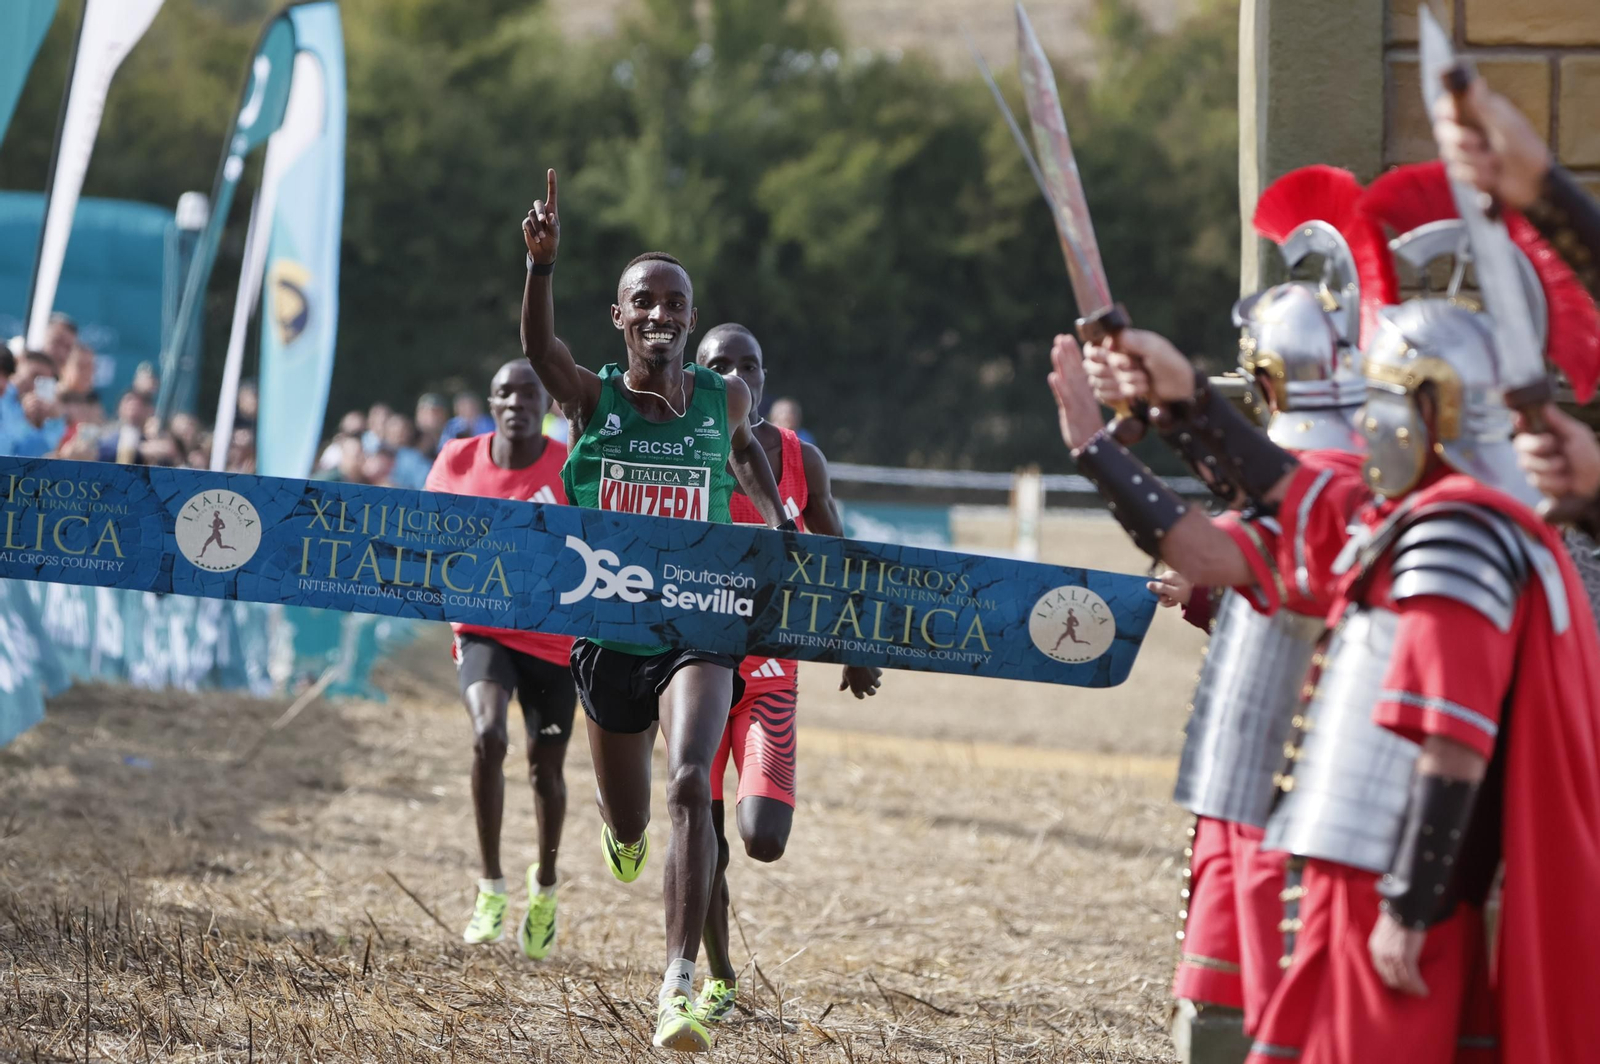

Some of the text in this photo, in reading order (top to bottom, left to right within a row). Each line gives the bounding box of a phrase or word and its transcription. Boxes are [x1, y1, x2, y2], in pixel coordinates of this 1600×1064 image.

[629, 439, 684, 456] Facsa
[631, 468, 680, 483] ITÁLICA
[18, 477, 101, 501] CROSS
[17, 497, 129, 515] INTERNACIONAL
[183, 493, 255, 528] ITÁLICA
[407, 510, 490, 537] CROSS
[405, 531, 518, 553] INTERNACIONAL
[18, 553, 59, 566] CROSS
[61, 557, 124, 572] COUNTRY
[298, 535, 513, 597] ITÁLICA
[663, 564, 756, 589] Diputación
[887, 566, 970, 593] CROSS
[299, 579, 512, 611] INTERNATIONAL CROSS COUNTRY
[661, 583, 754, 617] Sevilla
[886, 586, 998, 611] INTERNACIONAL
[778, 589, 993, 652] ITÁLICA
[778, 632, 992, 664] INTERNATIONAL CROSS COUNTRY
